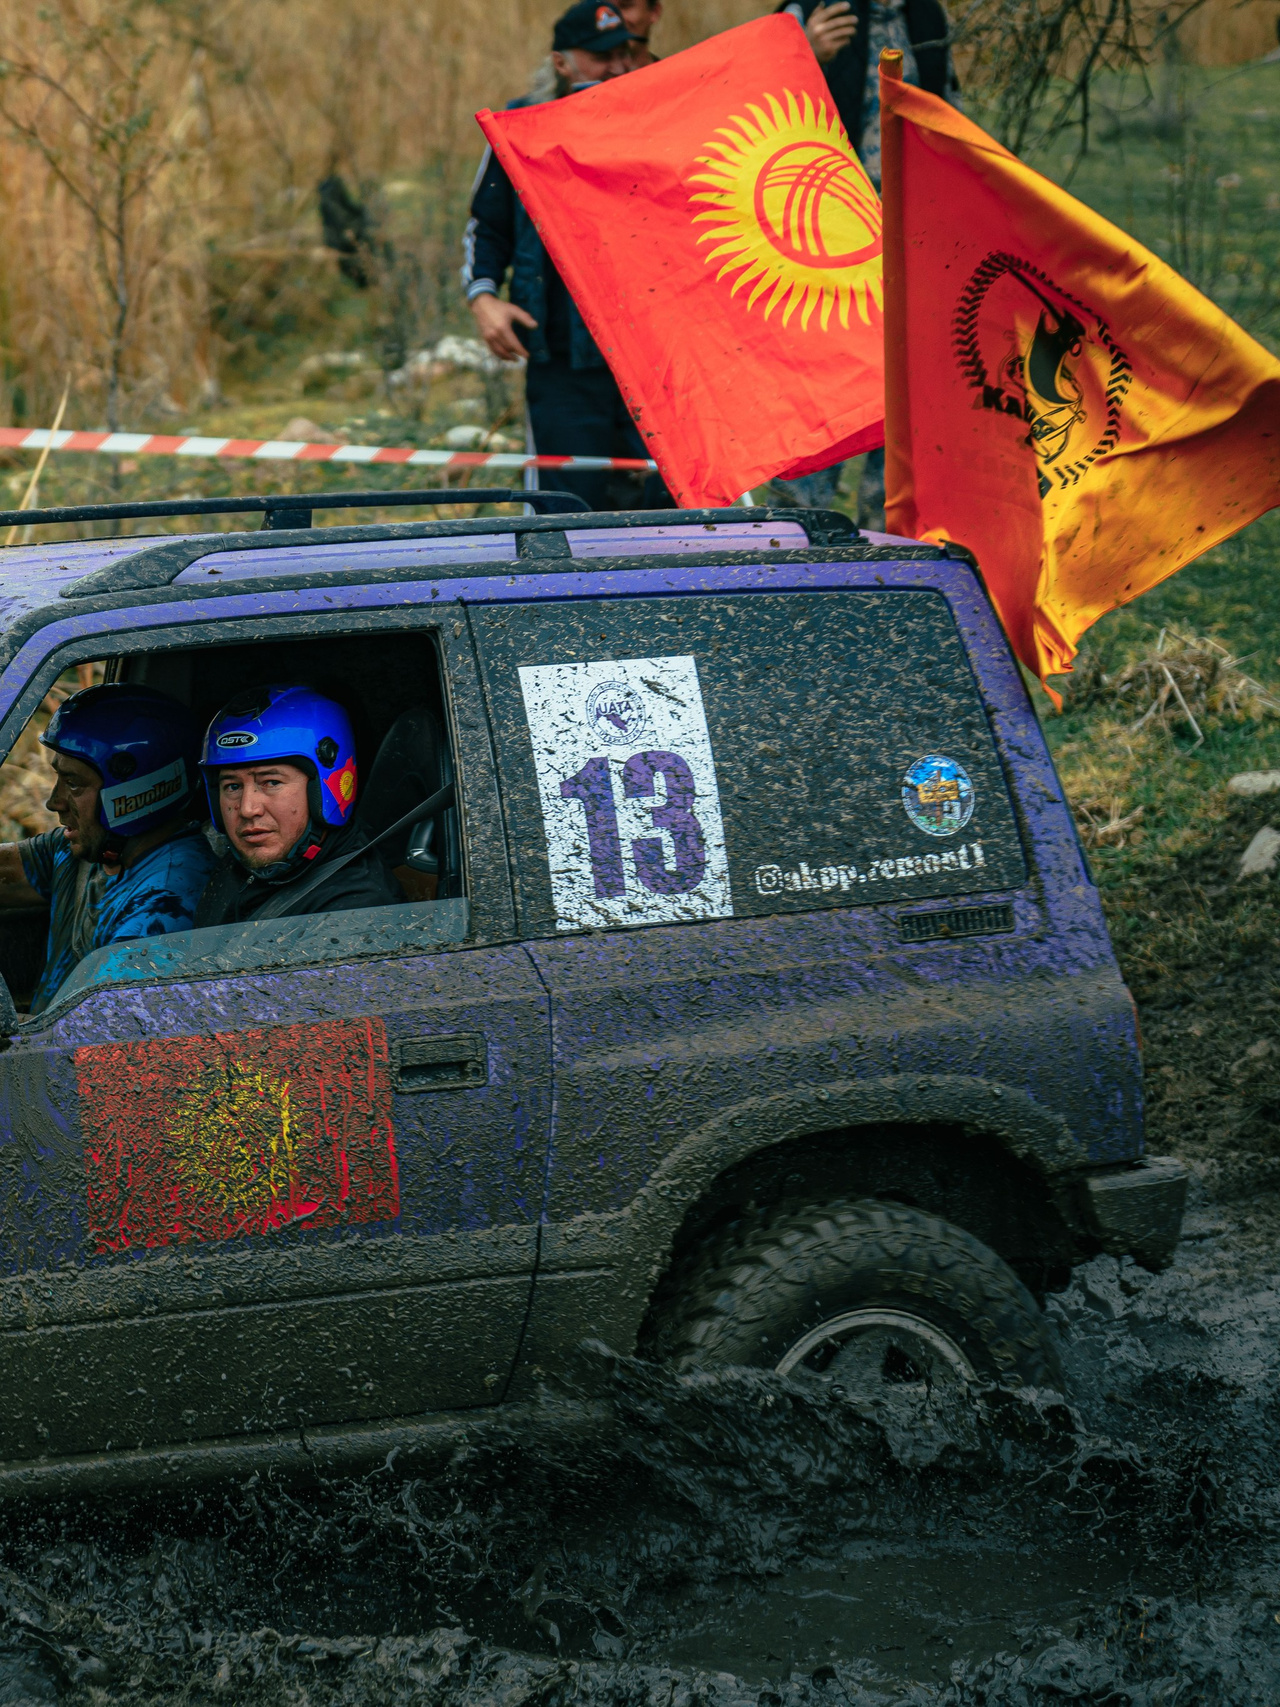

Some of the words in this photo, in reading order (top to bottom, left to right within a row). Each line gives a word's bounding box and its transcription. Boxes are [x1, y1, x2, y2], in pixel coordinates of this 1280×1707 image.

[597, 700, 635, 714] UATA
[111, 775, 183, 818] Havoline
[559, 751, 706, 898] 13
